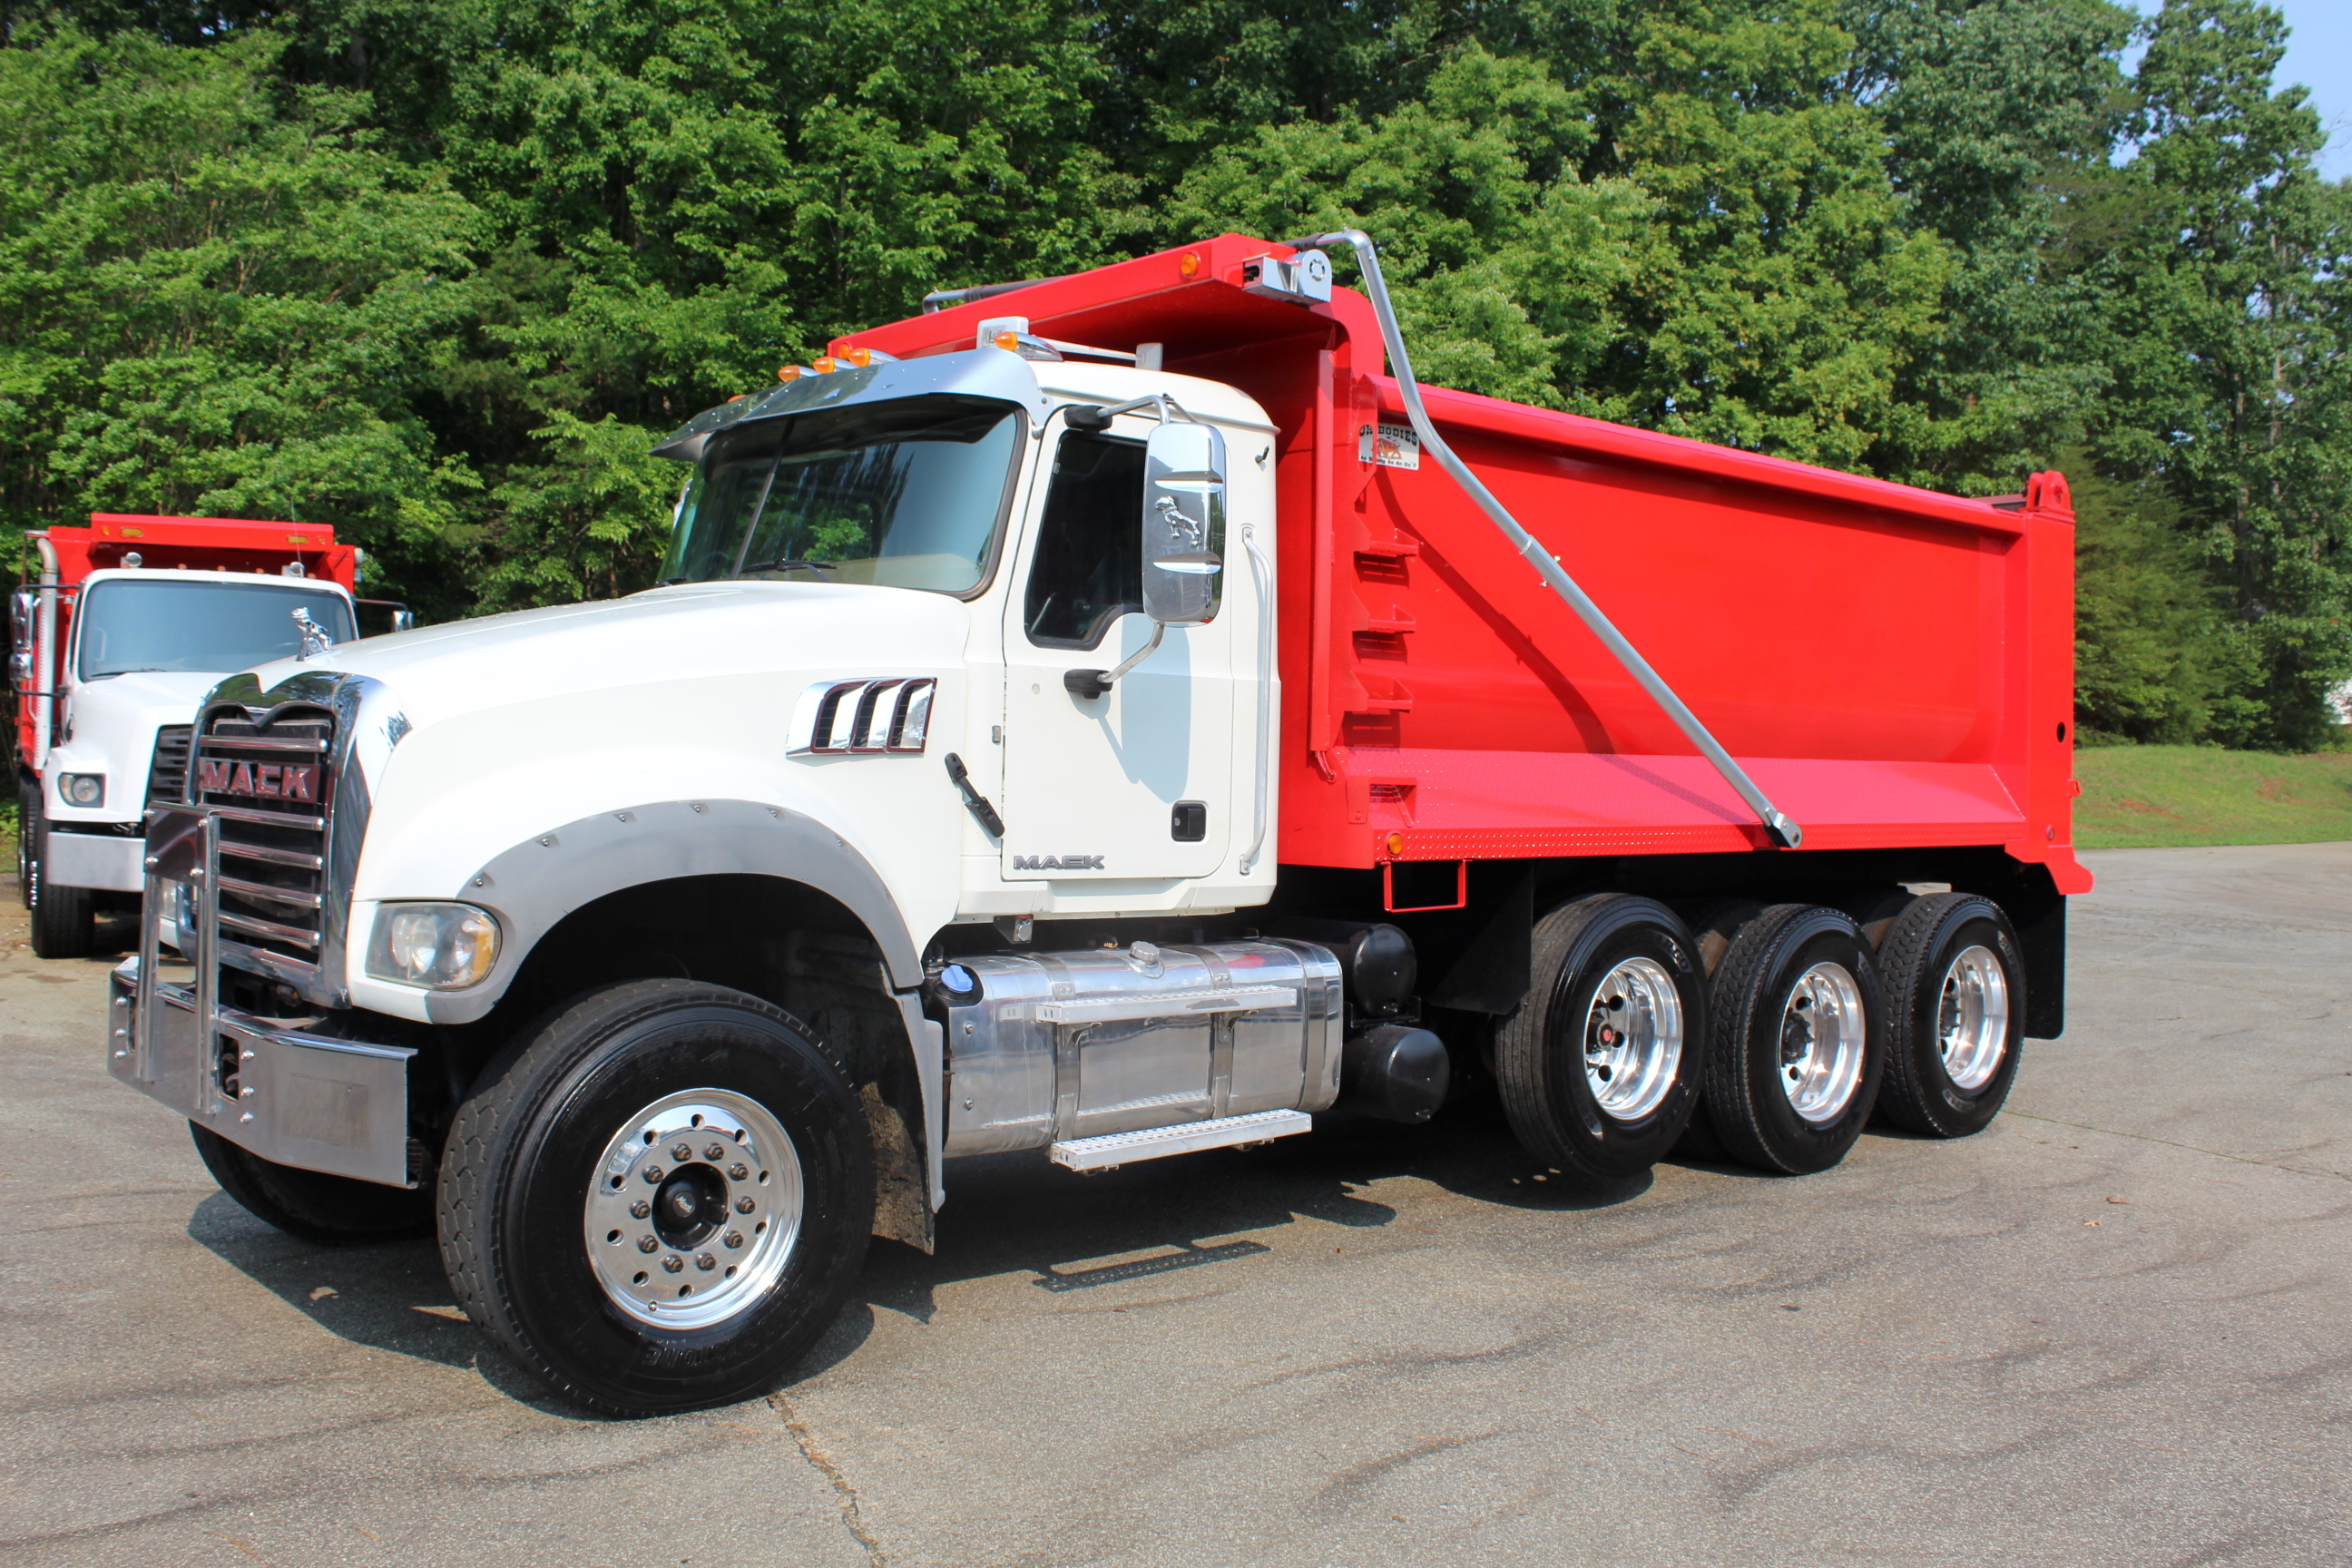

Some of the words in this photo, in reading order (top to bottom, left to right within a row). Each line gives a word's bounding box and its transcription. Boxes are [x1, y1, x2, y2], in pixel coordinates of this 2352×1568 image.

[1378, 425, 1417, 446] BODIES
[201, 760, 311, 799] MACK
[1014, 855, 1105, 870] MACK
